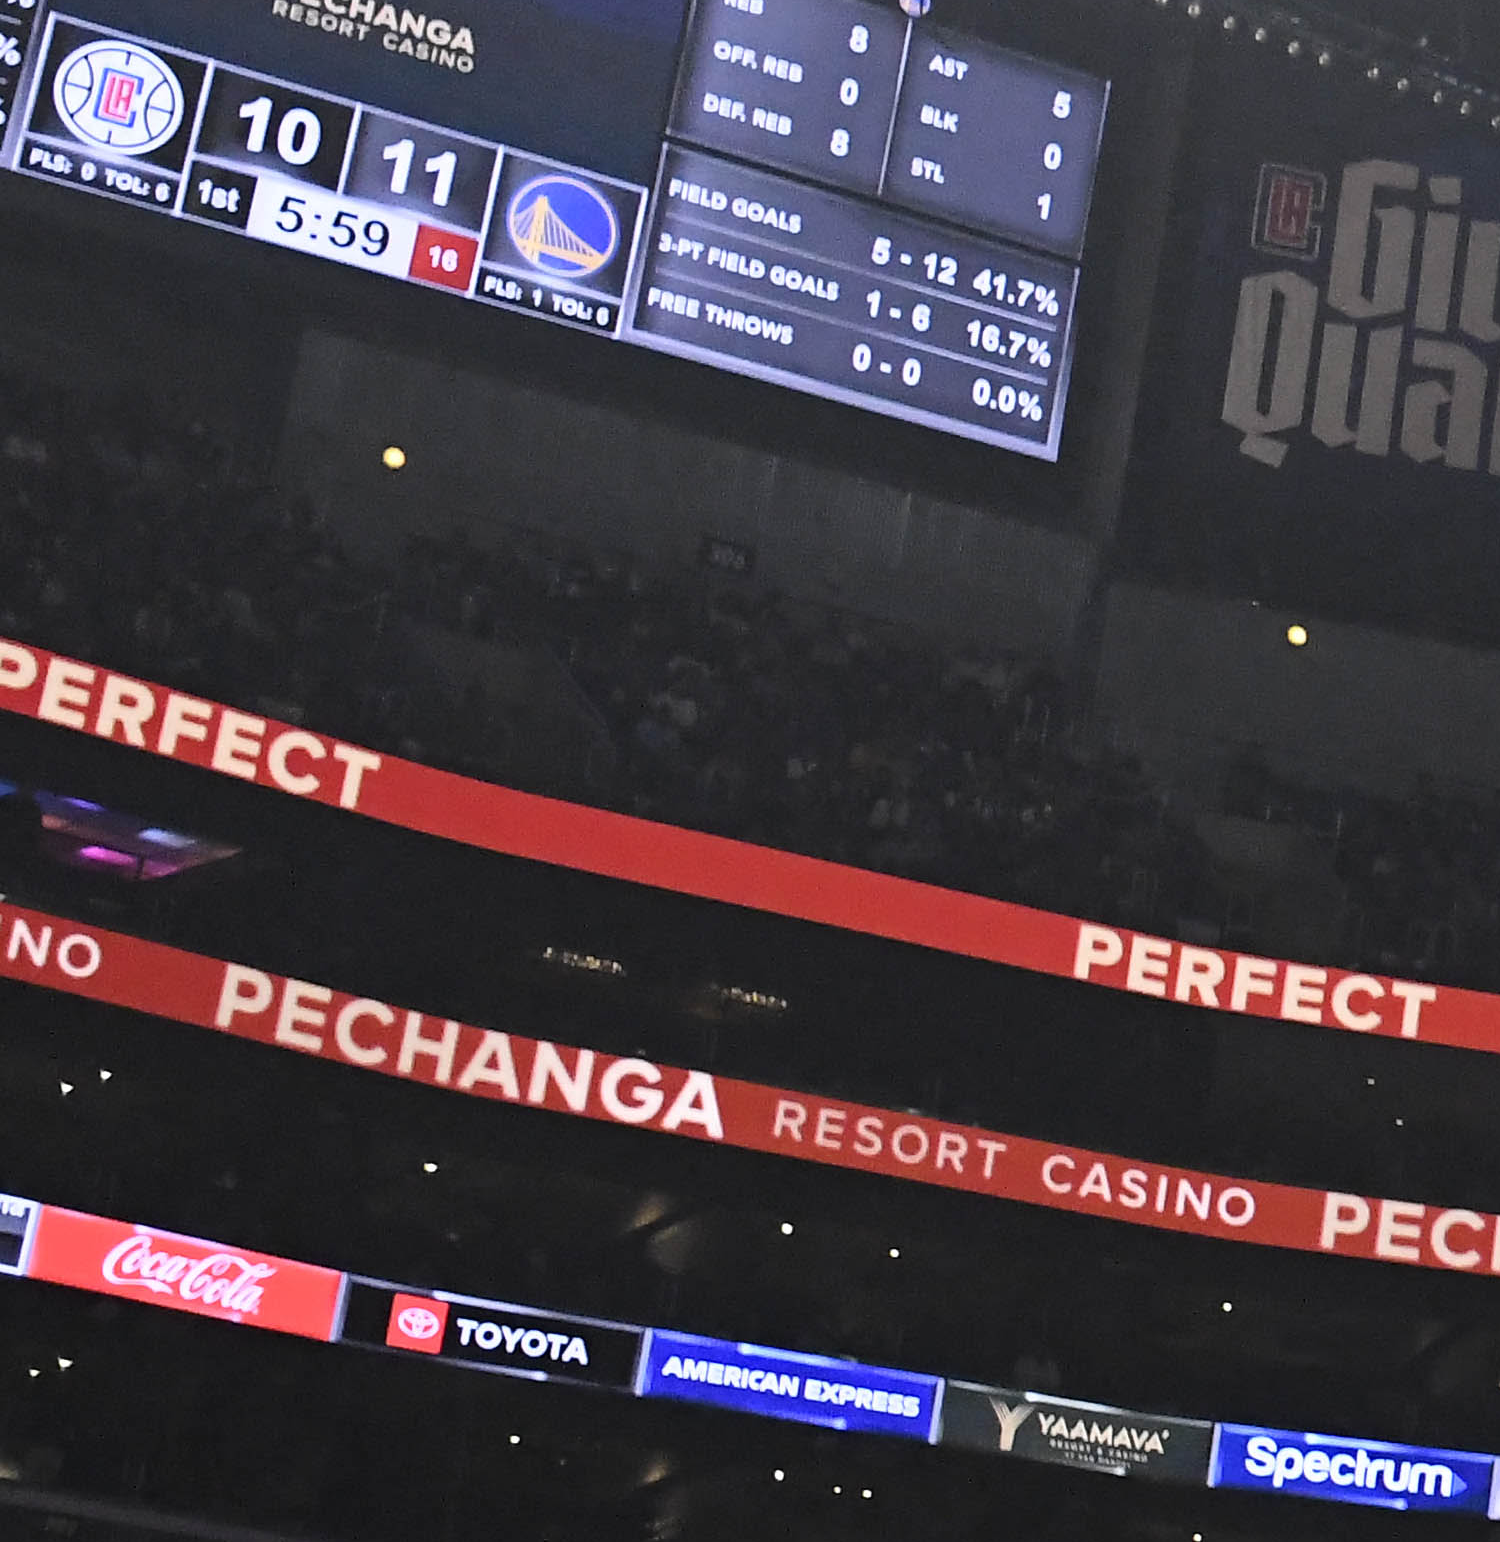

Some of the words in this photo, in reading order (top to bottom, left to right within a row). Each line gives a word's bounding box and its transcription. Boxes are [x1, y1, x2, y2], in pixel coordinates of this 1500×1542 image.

[382, 32, 476, 75] CASINO
[849, 24, 869, 54] 8
[839, 78, 859, 107] 0
[1053, 91, 1073, 119] 5
[238, 96, 321, 165] 10
[382, 139, 458, 208] 11
[830, 128, 850, 158] 8
[1043, 143, 1063, 172] 0
[198, 177, 240, 213] 1st
[274, 196, 390, 257] 5:59
[1036, 193, 1054, 222] 1
[668, 178, 727, 212] FIELD
[731, 196, 801, 234] GOALS
[871, 236, 892, 266] 5
[923, 252, 958, 287] 12
[972, 268, 1059, 317] 41.7%
[707, 246, 765, 280] FIELD
[769, 263, 839, 302] GOALS
[866, 290, 881, 318] 1
[911, 304, 931, 332] 6
[967, 319, 1052, 369] 16.7%
[647, 287, 700, 320] FREE
[705, 302, 794, 346] THROWS
[852, 343, 871, 371] 0
[903, 358, 922, 387] 0
[972, 378, 1044, 423] 0.0%
[1073, 923, 1437, 1039] PERFECT
[214, 960, 724, 1140] PECHANGA
[773, 1099, 1007, 1179] RESORT
[1041, 1154, 1256, 1227] CASINO
[456, 1317, 589, 1366] TOYOTA
[661, 1356, 799, 1399] AMERICAN
[804, 1377, 921, 1418] EXPRESS
[1245, 1436, 1456, 1497] Spectrum
